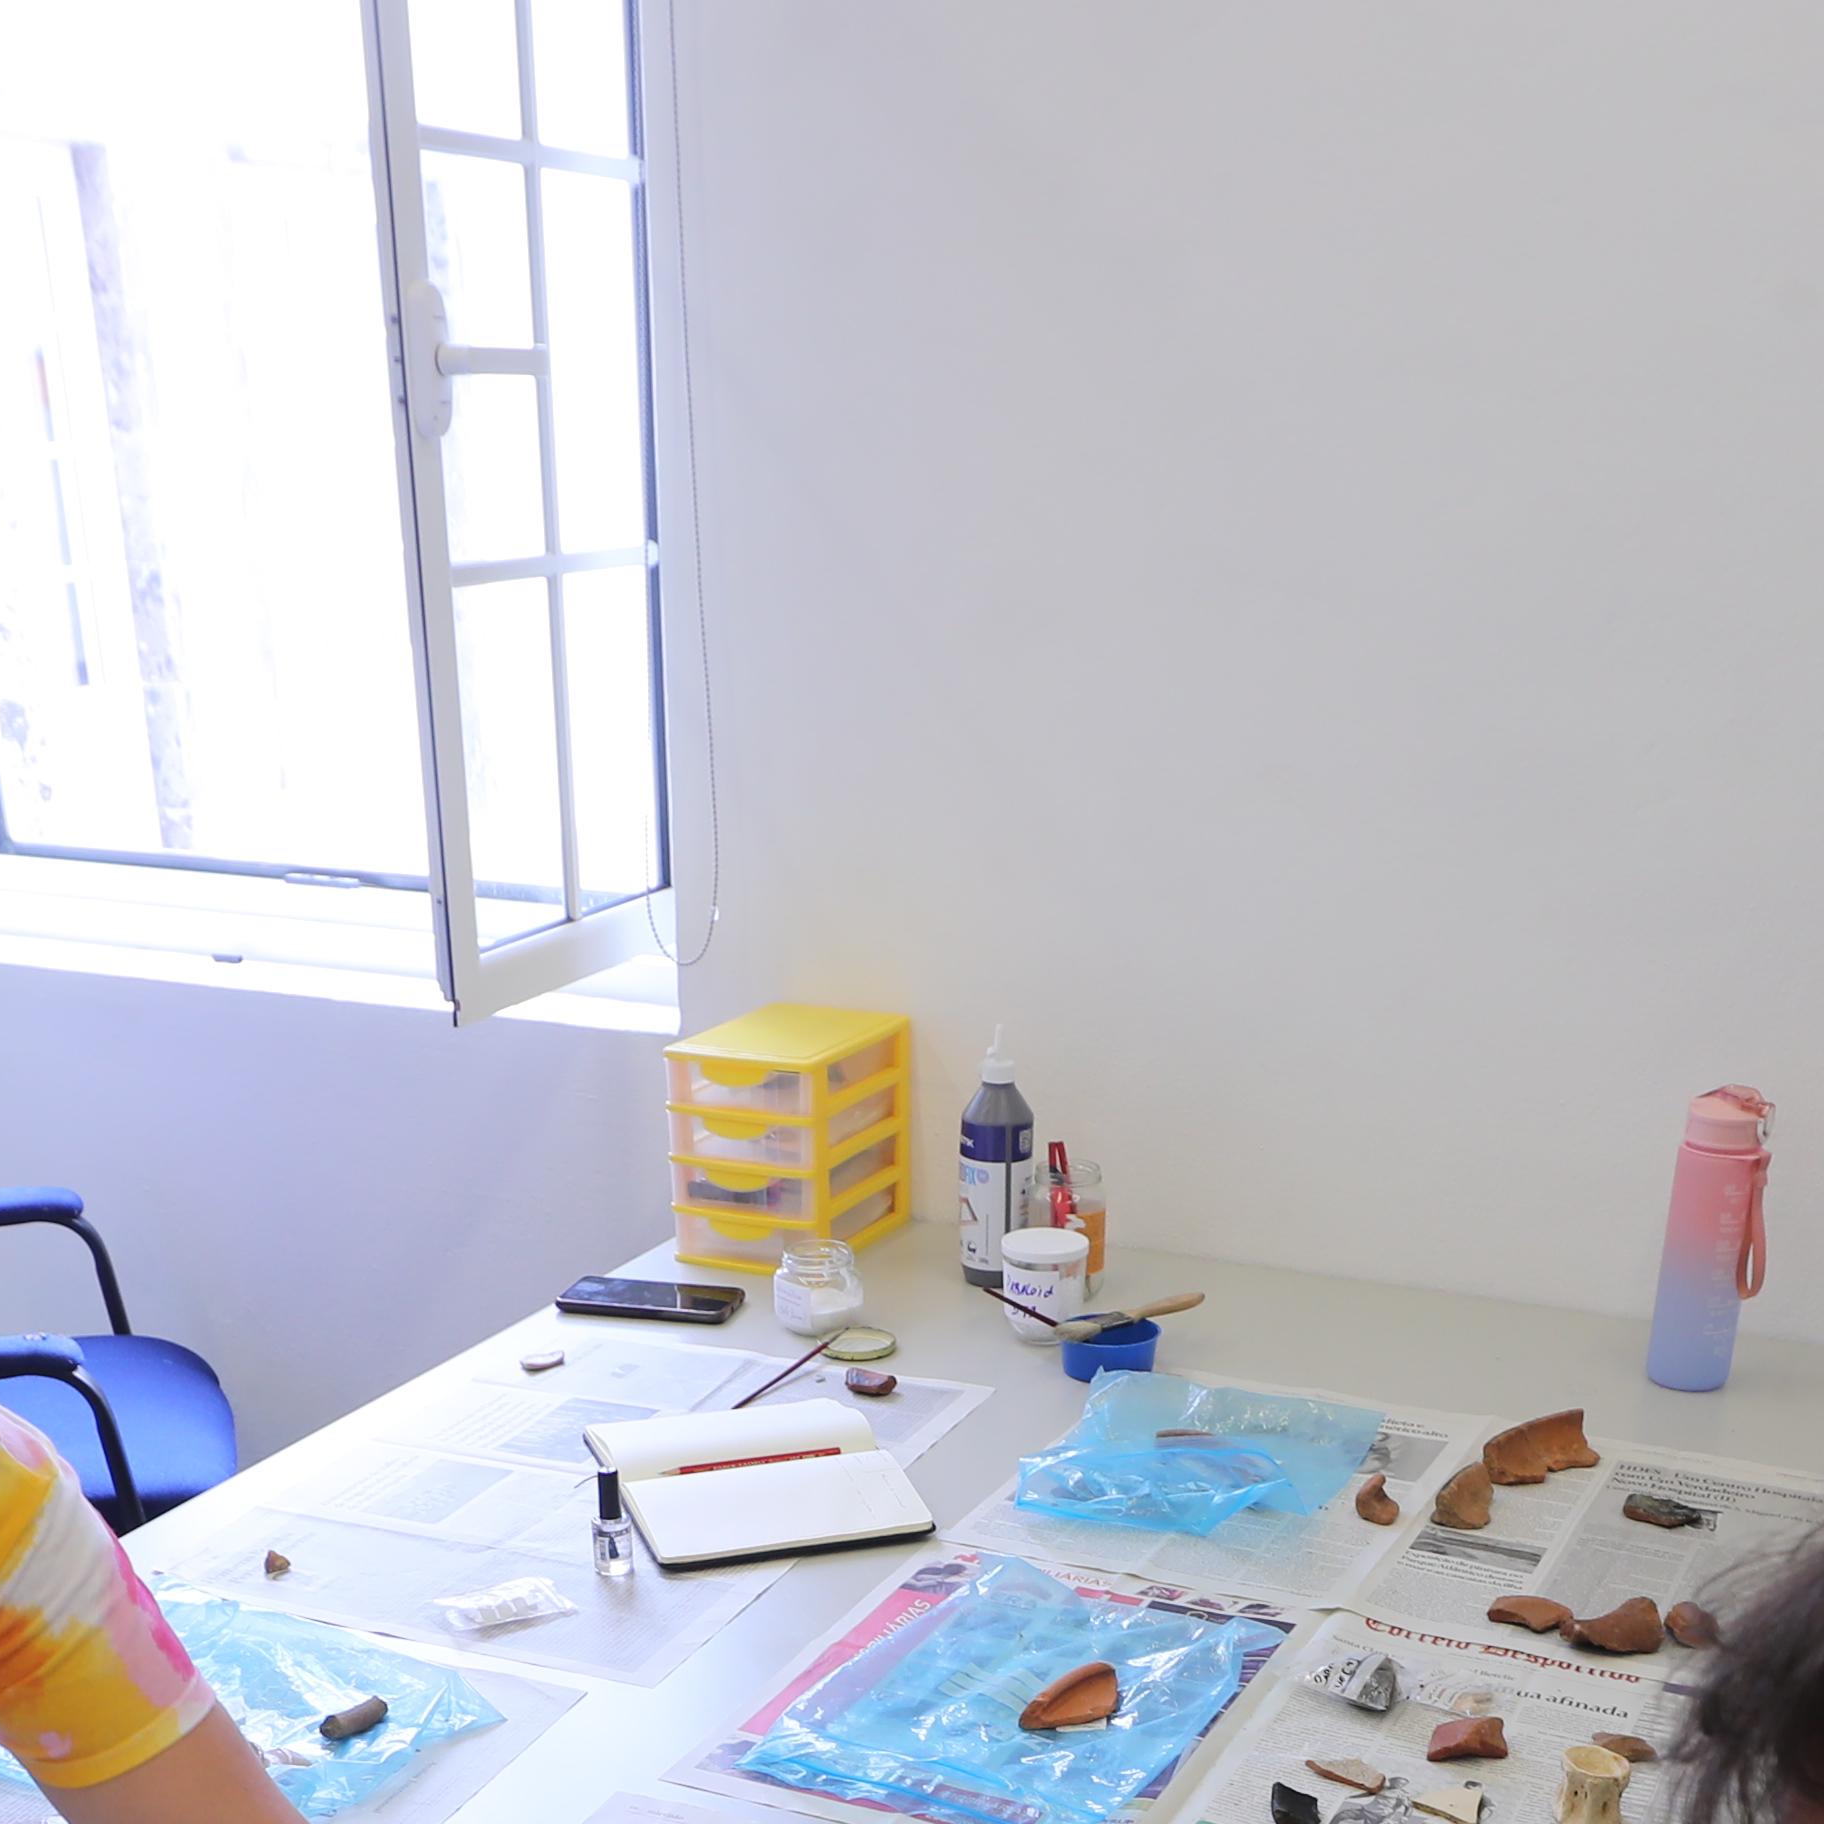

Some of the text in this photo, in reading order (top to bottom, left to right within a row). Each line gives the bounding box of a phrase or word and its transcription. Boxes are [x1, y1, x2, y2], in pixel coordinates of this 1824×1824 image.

[1651, 1483, 1712, 1501] Hospital
[1676, 1480, 1756, 1499] Verdadeiro
[1545, 1691, 1629, 1719] afinada
